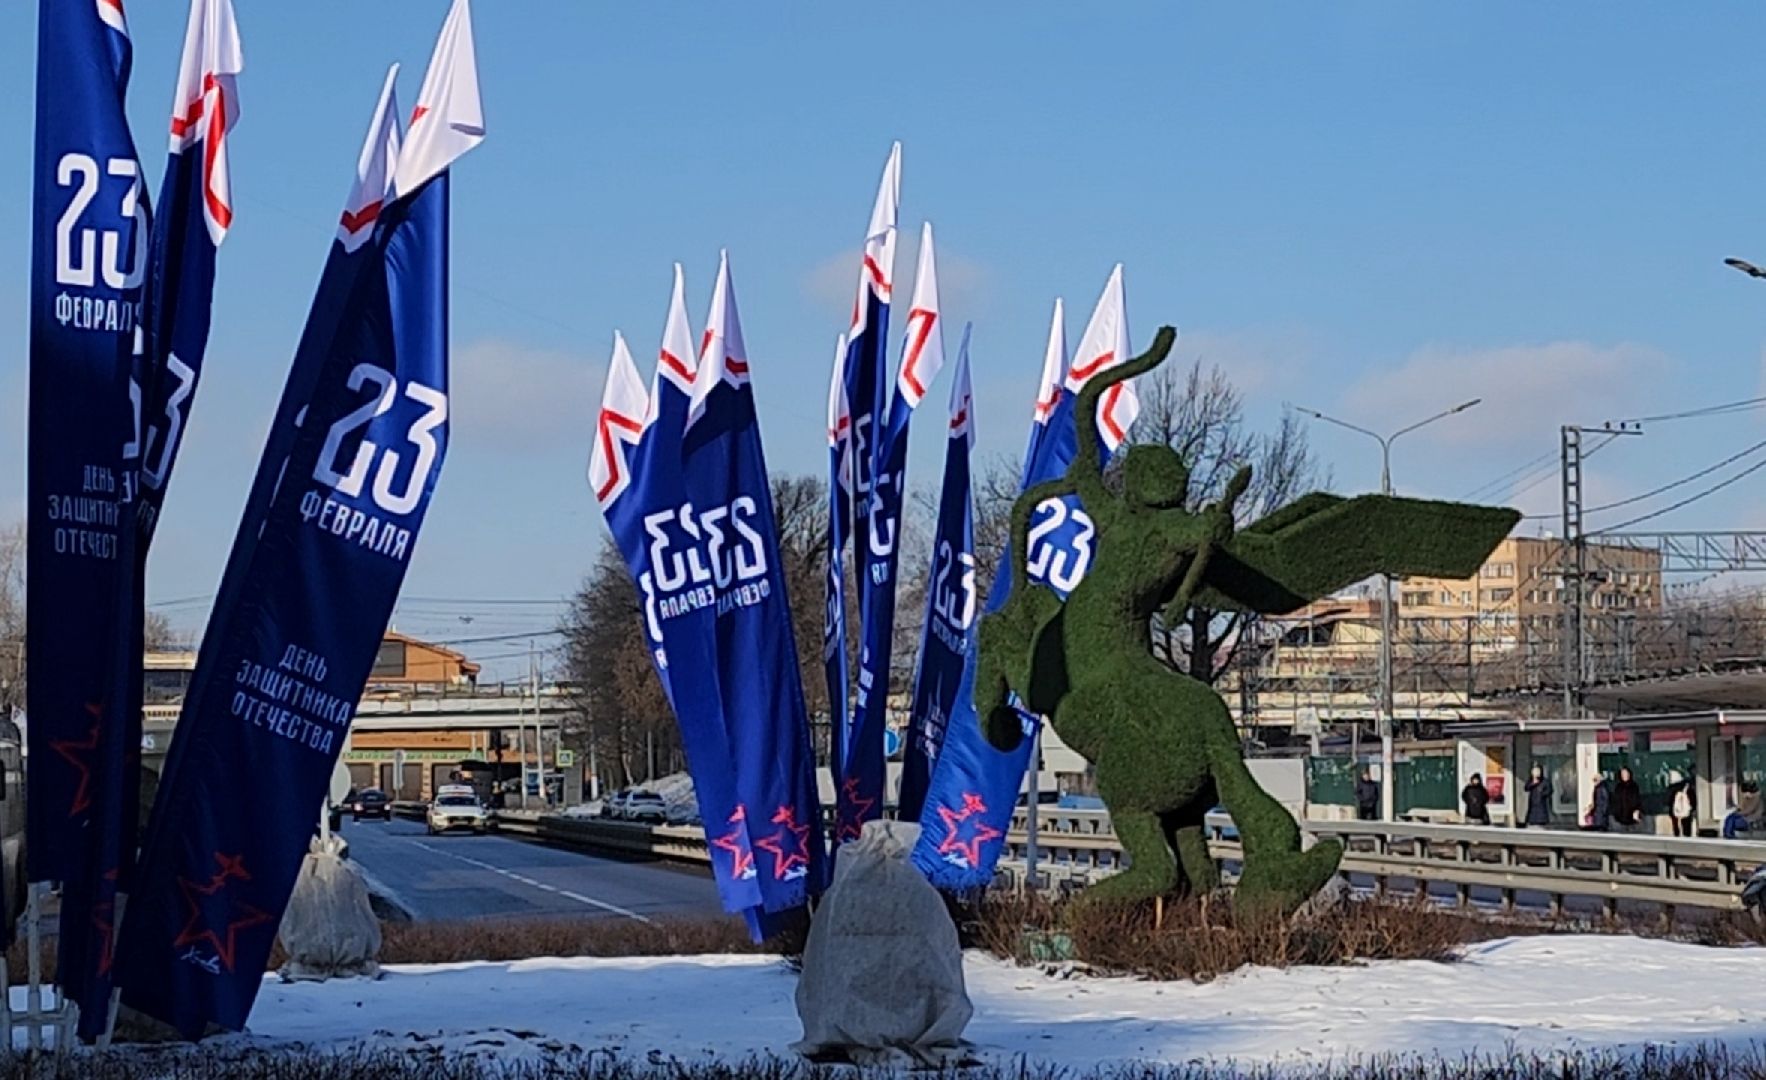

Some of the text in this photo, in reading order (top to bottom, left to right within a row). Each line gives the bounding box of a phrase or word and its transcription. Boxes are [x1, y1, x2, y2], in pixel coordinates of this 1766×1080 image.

[56, 153, 148, 289] 23
[312, 362, 447, 515] 23
[83, 464, 115, 492] ДЕНЬ
[300, 489, 411, 561] ФЕВРАЛЯ
[1027, 496, 1094, 592] 23
[934, 540, 977, 631] 23
[236, 659, 351, 727] ЗАЩИТНИКА
[278, 643, 328, 682] ДЕНЬ
[231, 690, 334, 755] ОТЕЧЕСТВА
